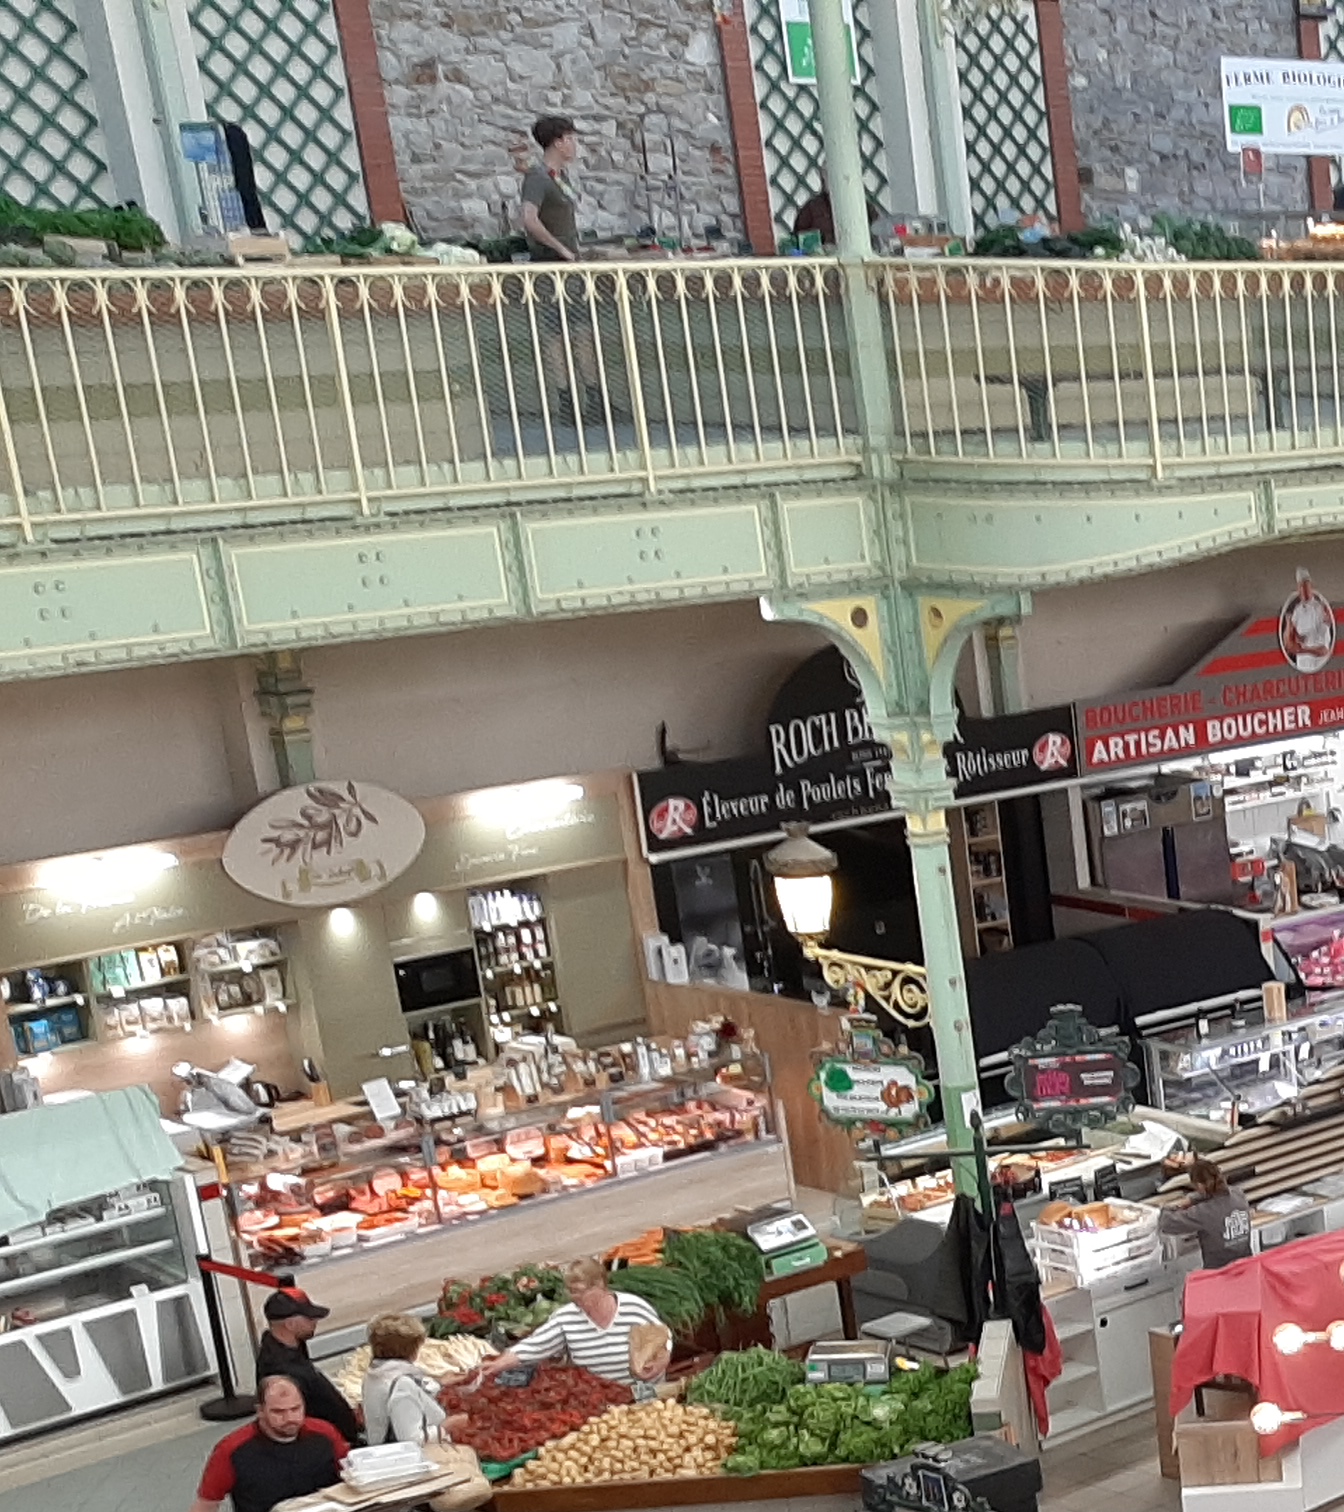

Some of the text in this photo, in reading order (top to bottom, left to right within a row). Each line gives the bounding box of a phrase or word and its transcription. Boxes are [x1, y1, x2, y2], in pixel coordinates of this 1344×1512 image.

[1085, 688, 1205, 731] BOUCHERIE
[1091, 722, 1197, 766] ARTISAN
[1206, 703, 1312, 744] BOUCHER
[769, 712, 841, 777] ROCH
[954, 744, 1030, 783] Rôtisseur
[701, 783, 770, 830] Éleveur
[774, 781, 797, 810] de
[799, 772, 862, 812] Poulets
